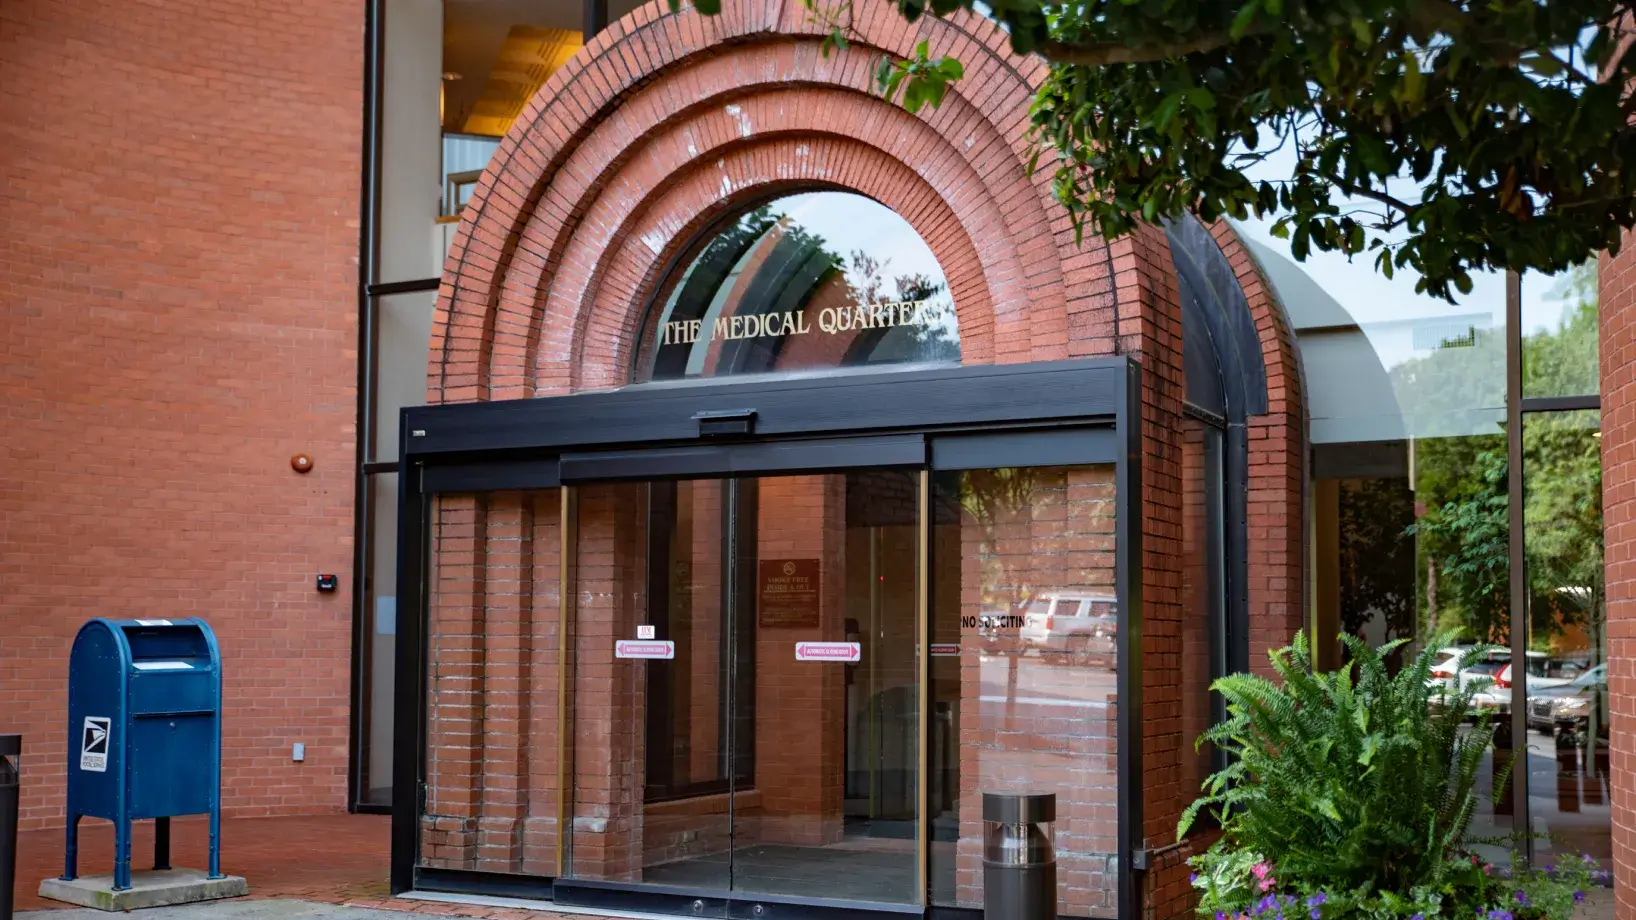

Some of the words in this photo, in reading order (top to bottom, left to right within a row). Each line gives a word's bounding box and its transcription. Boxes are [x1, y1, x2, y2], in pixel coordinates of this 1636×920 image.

[662, 319, 702, 345] THE
[710, 310, 811, 341] MEDICAL
[962, 615, 976, 628] NO
